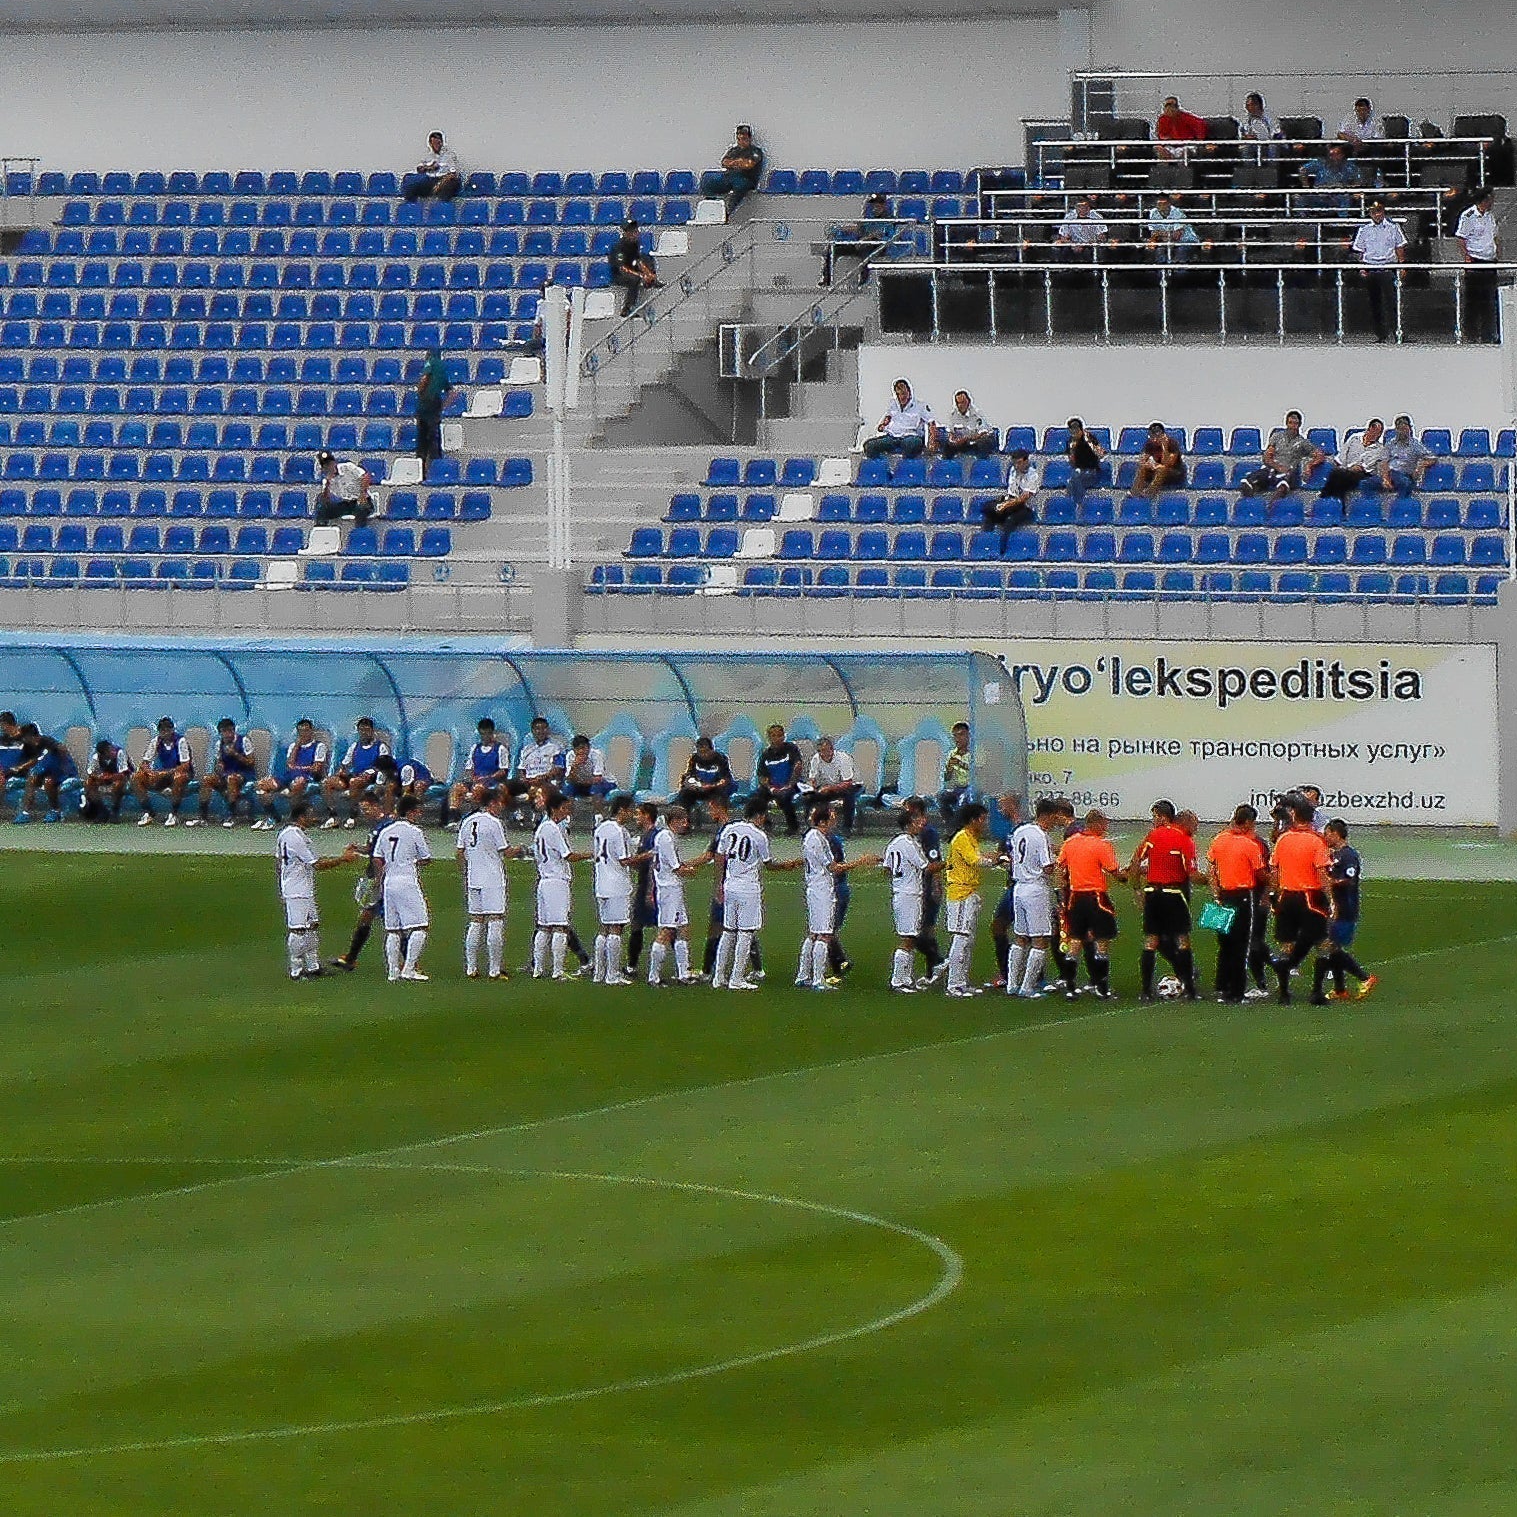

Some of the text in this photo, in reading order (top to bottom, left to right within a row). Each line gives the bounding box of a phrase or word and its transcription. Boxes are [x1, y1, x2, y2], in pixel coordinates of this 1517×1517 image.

[998, 653, 1422, 708] ryo‘lekspeditsia
[1072, 738, 1100, 753] на
[1109, 739, 1181, 759] рынке
[1189, 740, 1359, 762] транспортных
[1367, 743, 1446, 764] услуг»
[1062, 769, 1073, 784] 7
[388, 836, 400, 863] 7
[726, 833, 751, 862] 20
